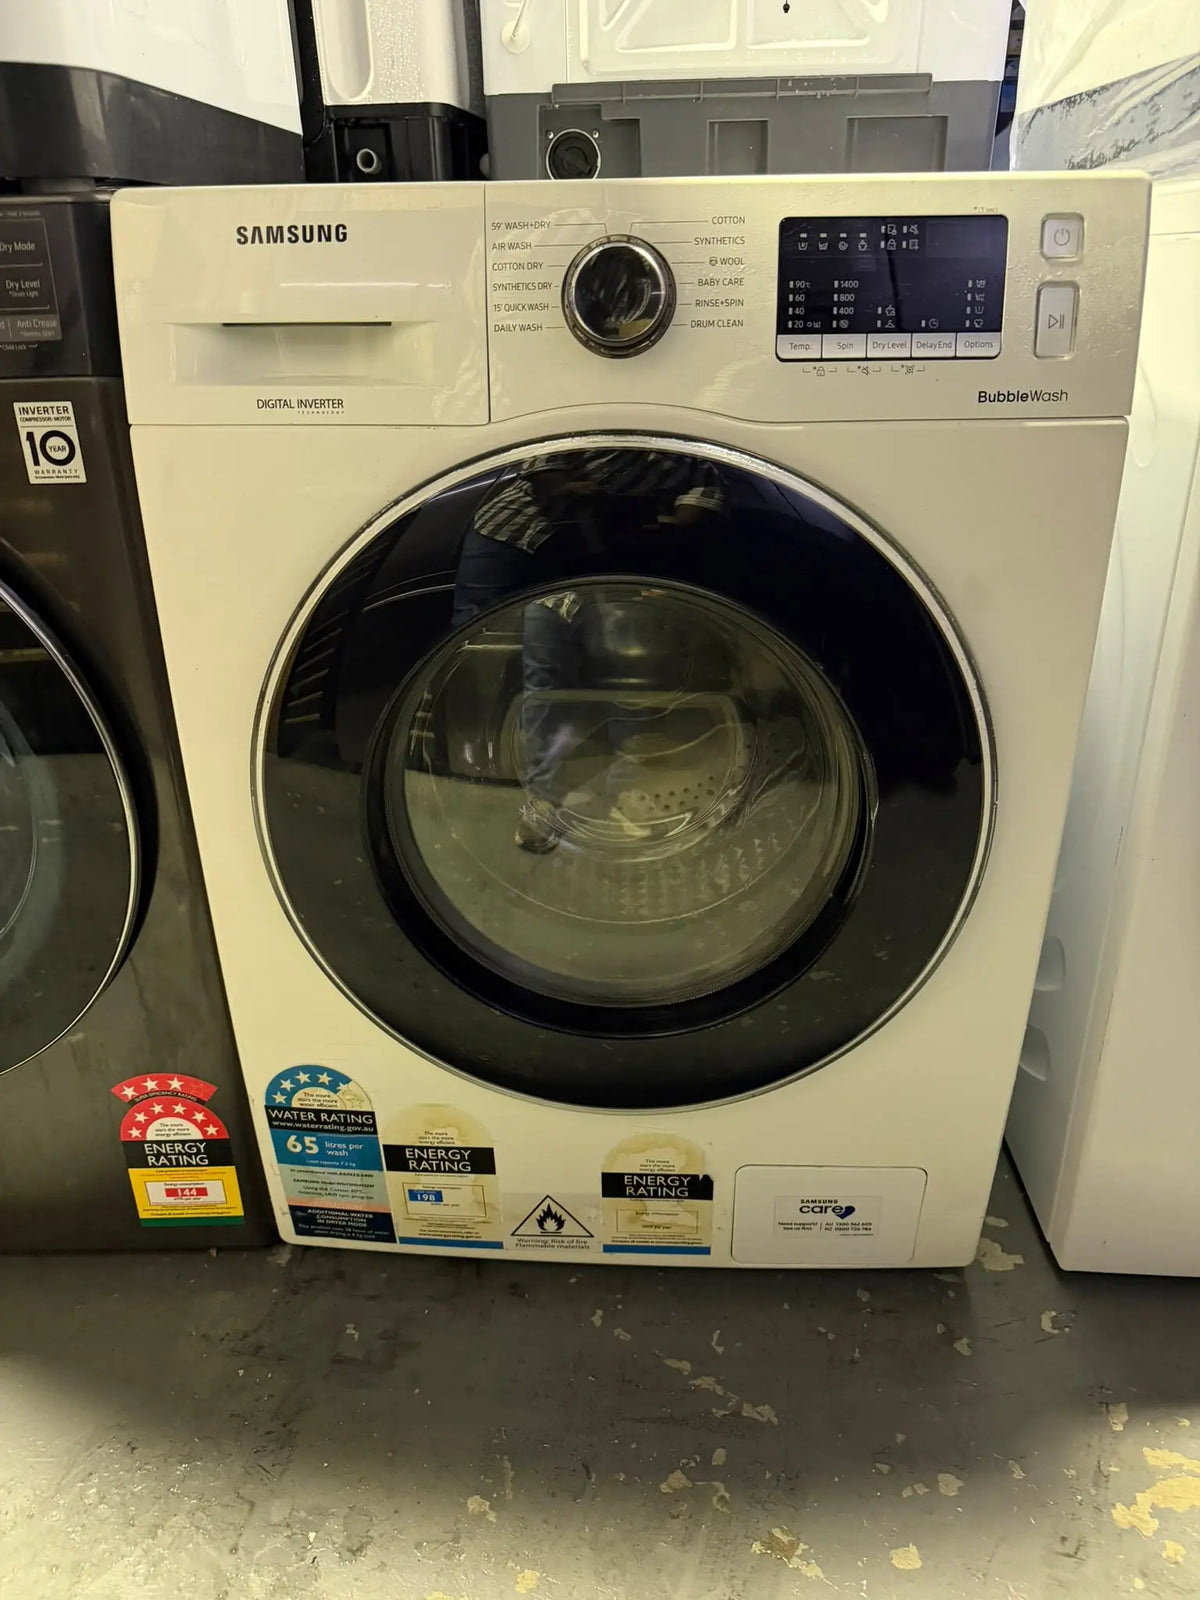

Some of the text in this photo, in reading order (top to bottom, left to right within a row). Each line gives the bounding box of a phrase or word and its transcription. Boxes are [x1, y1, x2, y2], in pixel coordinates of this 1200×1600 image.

[711, 216, 745, 225] COTTON
[505, 221, 551, 230] WASH+DRY
[236, 224, 348, 245] SAMSUNG
[694, 236, 745, 245] SYNTHETICS
[0, 241, 35, 253] Dry Mode
[492, 241, 532, 251] AIR WASH
[719, 257, 745, 265] WOOL
[492, 262, 544, 271] COTTON DRY
[6, 279, 40, 290] Dry Level
[492, 282, 553, 292] SYNTHETICS DRY
[697, 278, 745, 287] BABY CARE
[840, 280, 859, 288] 1400
[503, 303, 527, 312] QUICK
[527, 303, 549, 311] WASH
[695, 299, 744, 308] RINSE+SPIN
[794, 307, 805, 315] 40
[838, 307, 855, 315] 400
[17, 319, 32, 328] Anti
[493, 323, 543, 332] DAILY WASH
[690, 319, 744, 328] DRUM CLEAN
[794, 320, 804, 328] 20
[789, 342, 812, 352] Temp.
[837, 341, 854, 352] Spin
[872, 341, 907, 350] Dry Level
[916, 341, 952, 350] Delay End
[964, 340, 994, 349] Options
[256, 398, 344, 409] DIGITAL INVERTER
[19, 406, 70, 415] INVERTER
[26, 430, 76, 466] 10
[269, 1109, 373, 1124] WATER RATING
[272, 1120, 374, 1132] www.waterrating.gov.au
[144, 1142, 207, 1154] ENERGY
[286, 1134, 319, 1154] 65
[325, 1141, 346, 1149] litres
[405, 1148, 471, 1160] ENERGY
[147, 1154, 209, 1166] RATING
[409, 1160, 471, 1172] RATING
[624, 1175, 691, 1186] ENERGY
[177, 1188, 197, 1196] 144
[626, 1187, 689, 1197] RATING
[799, 1205, 844, 1214] care
